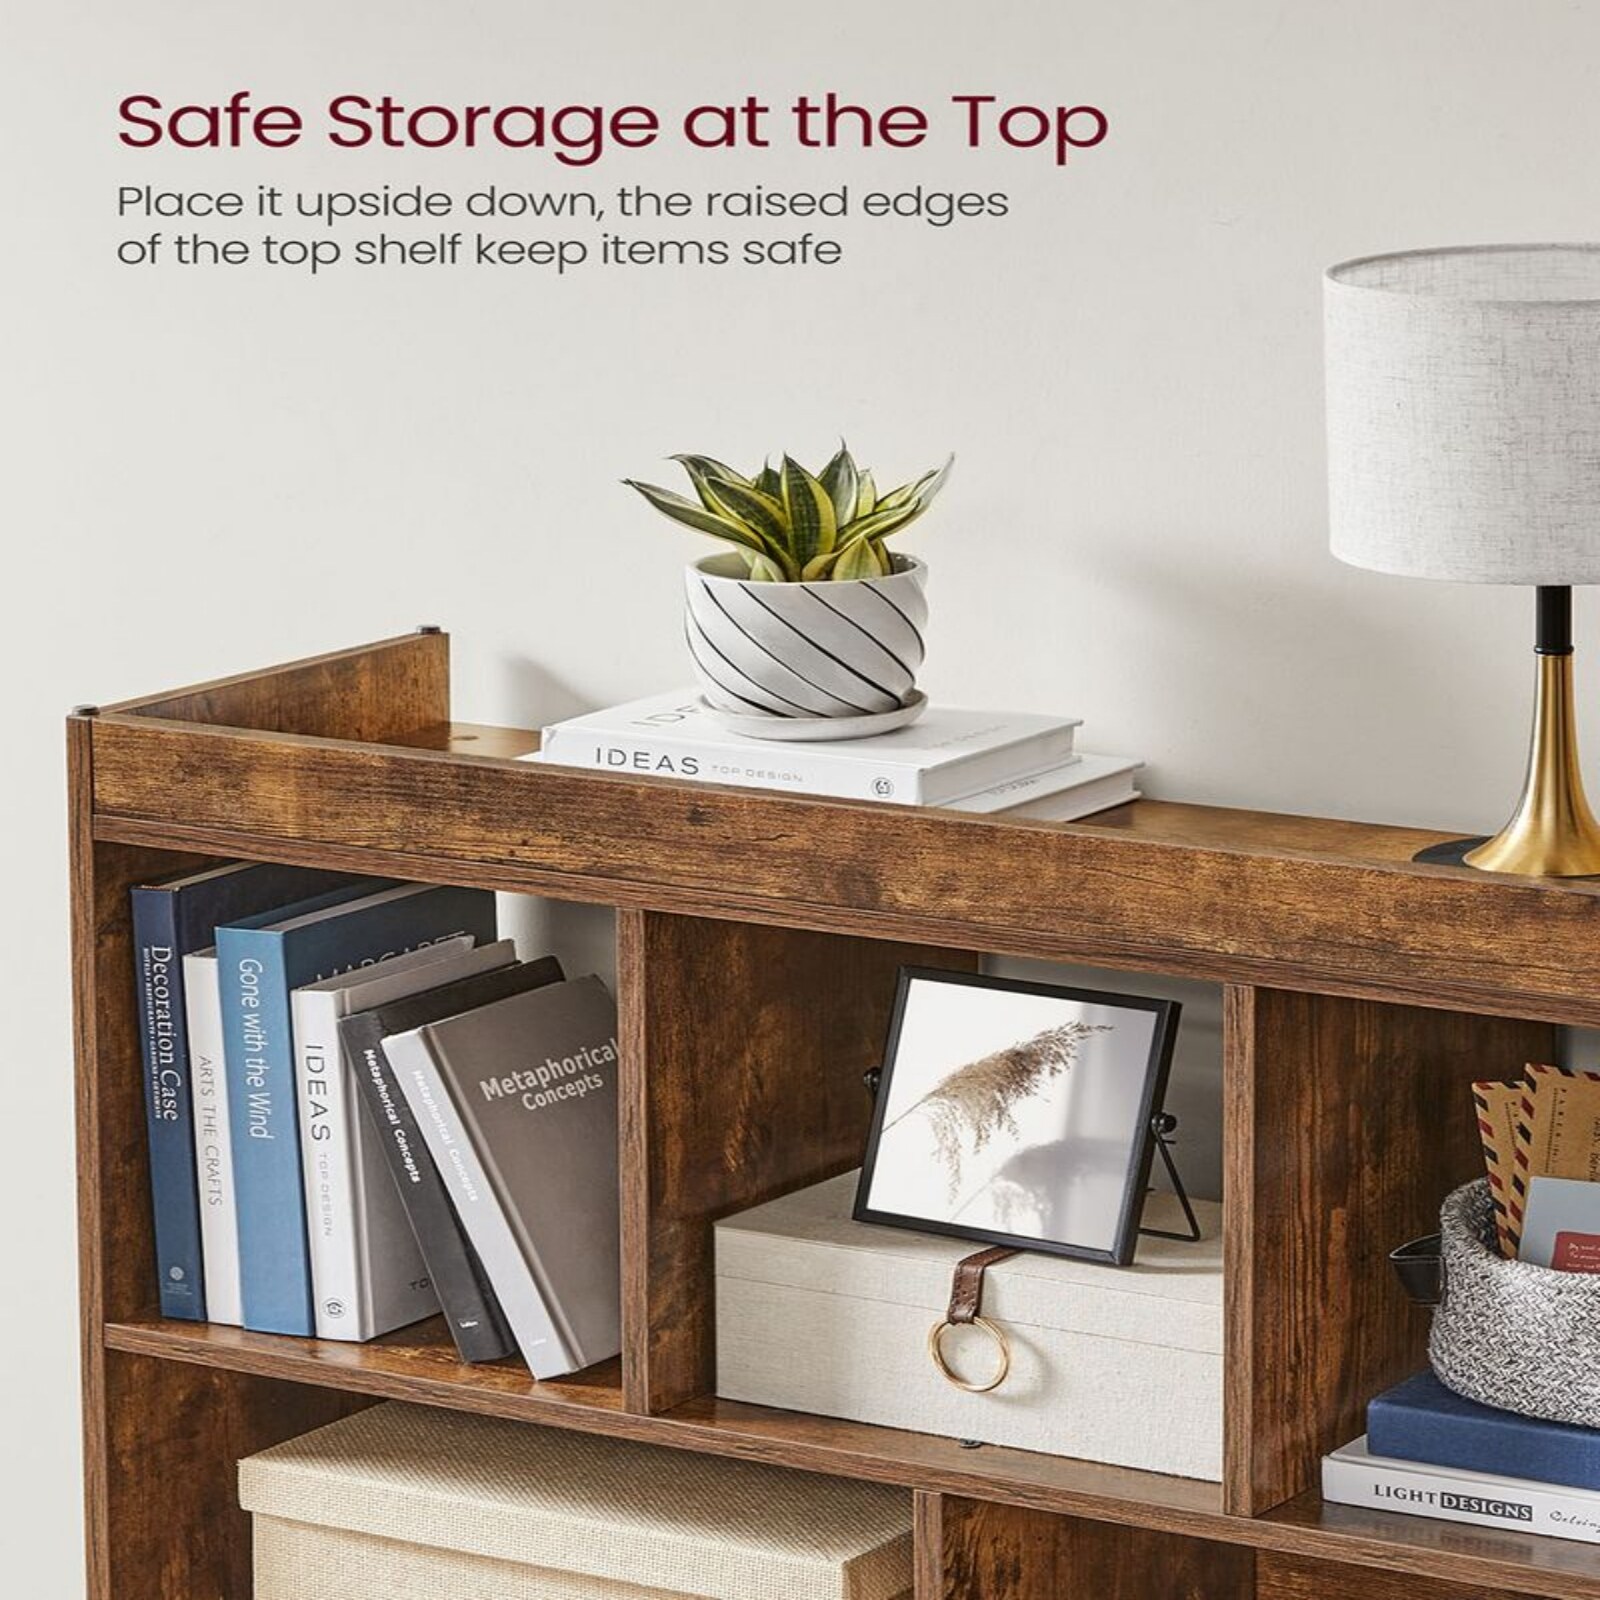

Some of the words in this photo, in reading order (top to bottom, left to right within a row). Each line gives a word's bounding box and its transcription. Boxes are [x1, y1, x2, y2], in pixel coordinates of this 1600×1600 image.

[595, 747, 700, 775] IDEAS
[711, 765, 741, 775] TOP
[745, 768, 804, 782] DESIGN
[151, 945, 178, 1065] Decoration
[239, 958, 263, 1009] Gone
[243, 1011, 267, 1056] with
[199, 1055, 216, 1097] ARTS
[246, 1058, 269, 1088] the
[304, 1045, 331, 1142] IDEAS
[479, 1037, 619, 1101] Metaphorical
[521, 1073, 604, 1111] Concepts
[159, 1069, 182, 1121] Case
[250, 1088, 274, 1140] Wind
[363, 1049, 400, 1126] Metaphorical
[394, 1128, 421, 1183] Concepts
[203, 1105, 219, 1137] THE
[412, 1070, 453, 1145] Metaphorical
[449, 1149, 478, 1202] Concepts
[205, 1144, 223, 1206] CRAFTS
[1374, 1484, 1440, 1505] LIGHT
[1442, 1494, 1532, 1521] DESIGNS
